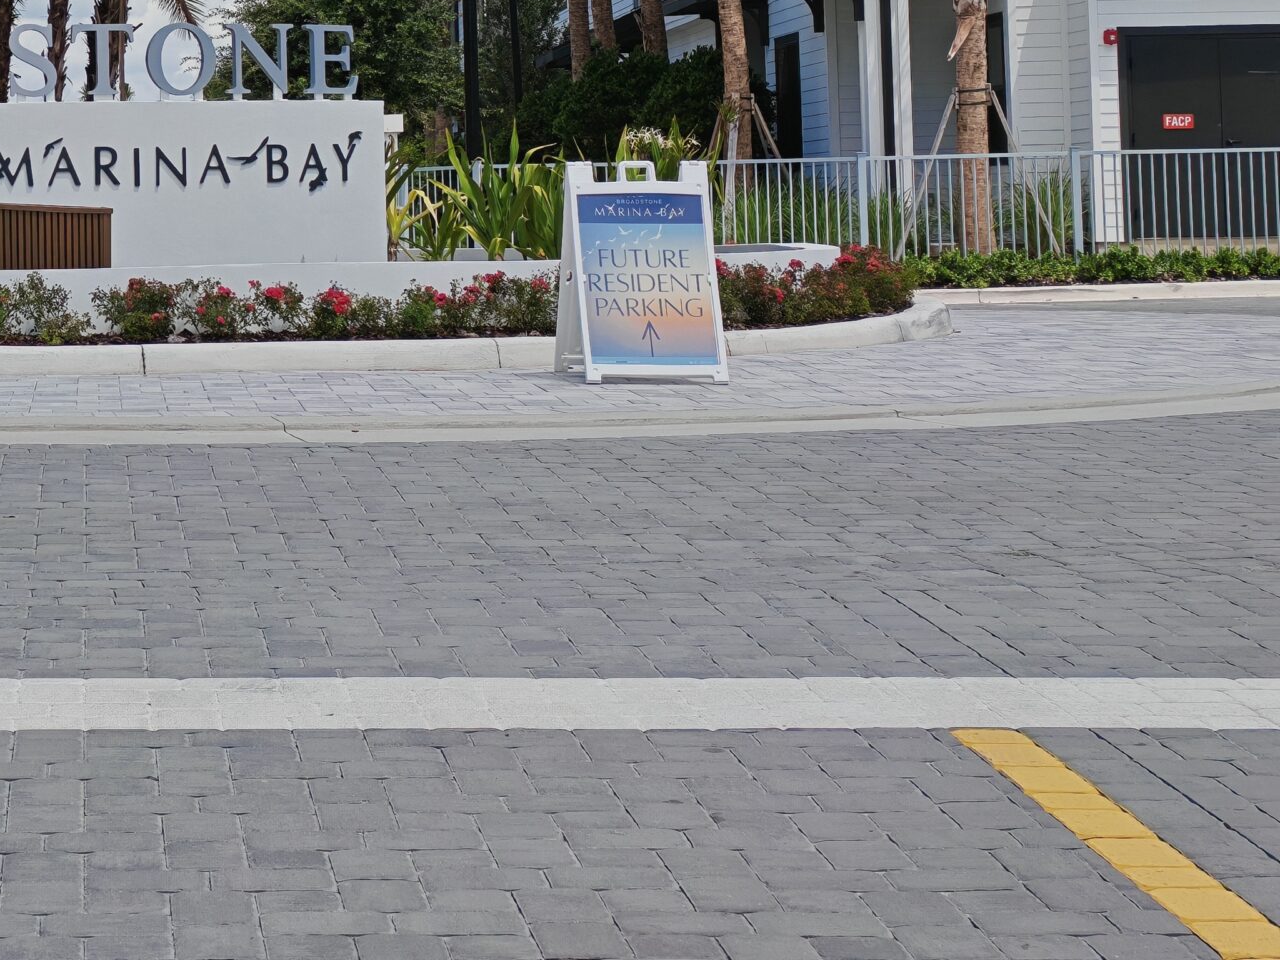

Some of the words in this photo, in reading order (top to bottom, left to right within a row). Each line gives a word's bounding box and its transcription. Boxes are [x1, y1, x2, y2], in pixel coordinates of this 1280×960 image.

[1166, 116, 1192, 127] FACP
[266, 141, 359, 185] BAY
[594, 207, 652, 217] MARINA
[660, 207, 686, 217] BAY
[598, 249, 690, 268] FUTURE
[588, 273, 704, 292] RESIDENT
[595, 297, 704, 317] PARKING
